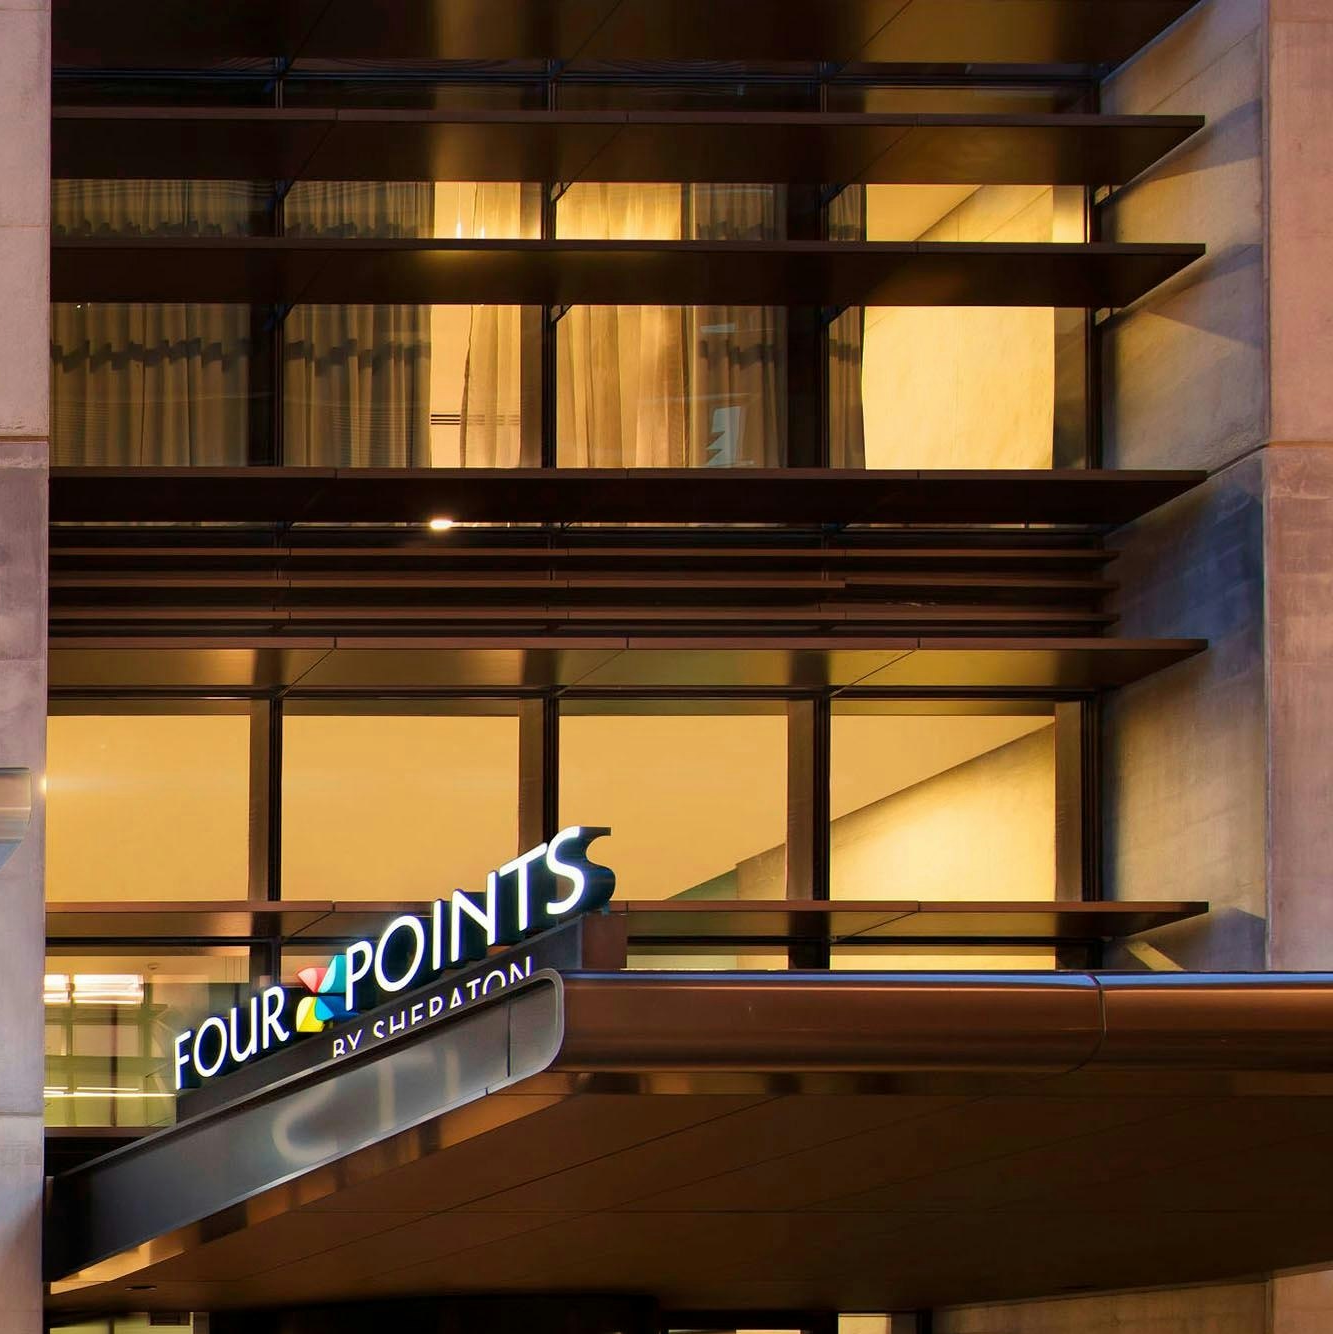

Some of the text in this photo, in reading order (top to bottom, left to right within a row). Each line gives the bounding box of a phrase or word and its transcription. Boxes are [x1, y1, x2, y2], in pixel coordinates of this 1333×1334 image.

[173, 824, 589, 1091] FOUR POINTS
[333, 1028, 364, 1059] BY
